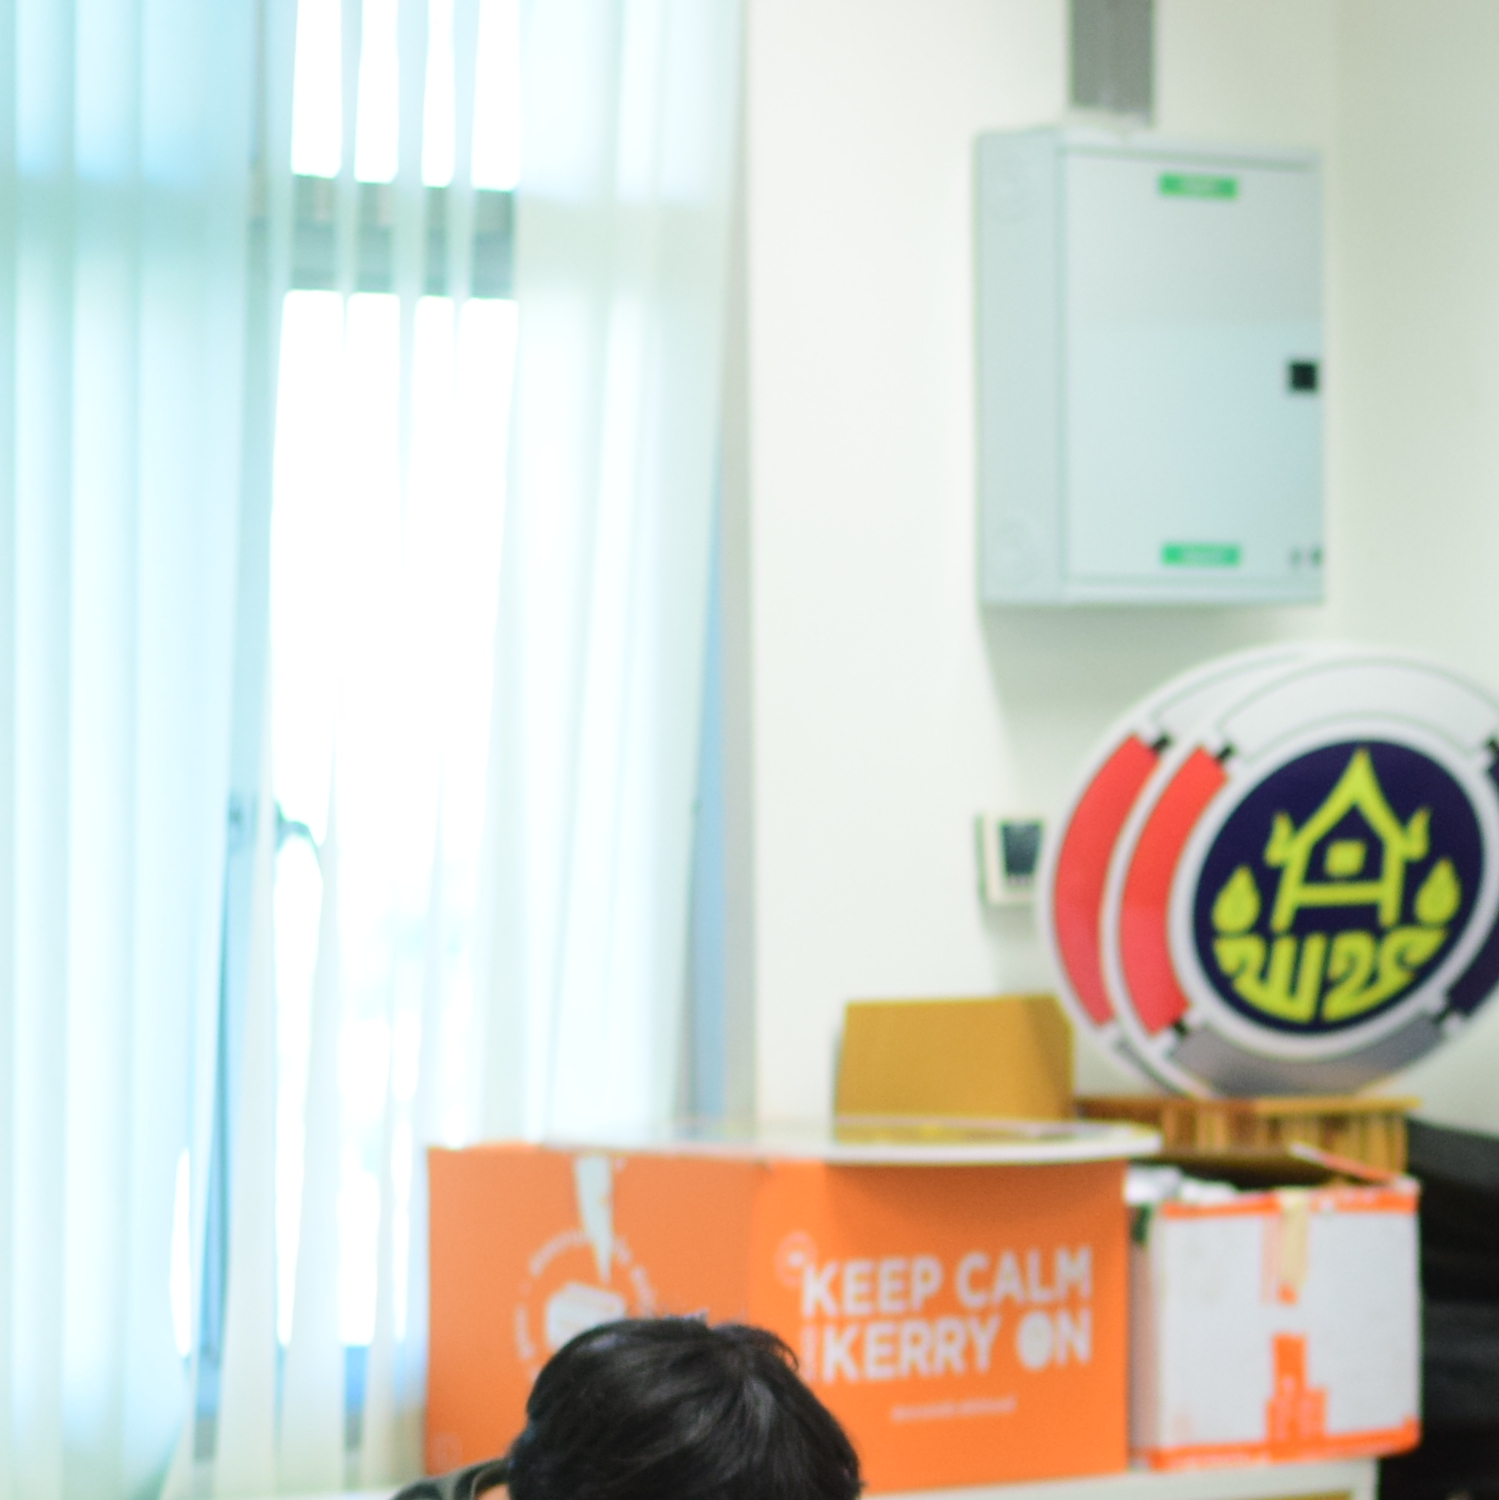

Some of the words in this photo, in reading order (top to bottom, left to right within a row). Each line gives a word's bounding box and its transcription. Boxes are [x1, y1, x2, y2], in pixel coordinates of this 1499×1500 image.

[801, 1254, 943, 1319] KEEP
[957, 1245, 1093, 1308] CALM
[823, 1313, 1002, 1383] KERRY
[1017, 1307, 1093, 1372] ON
